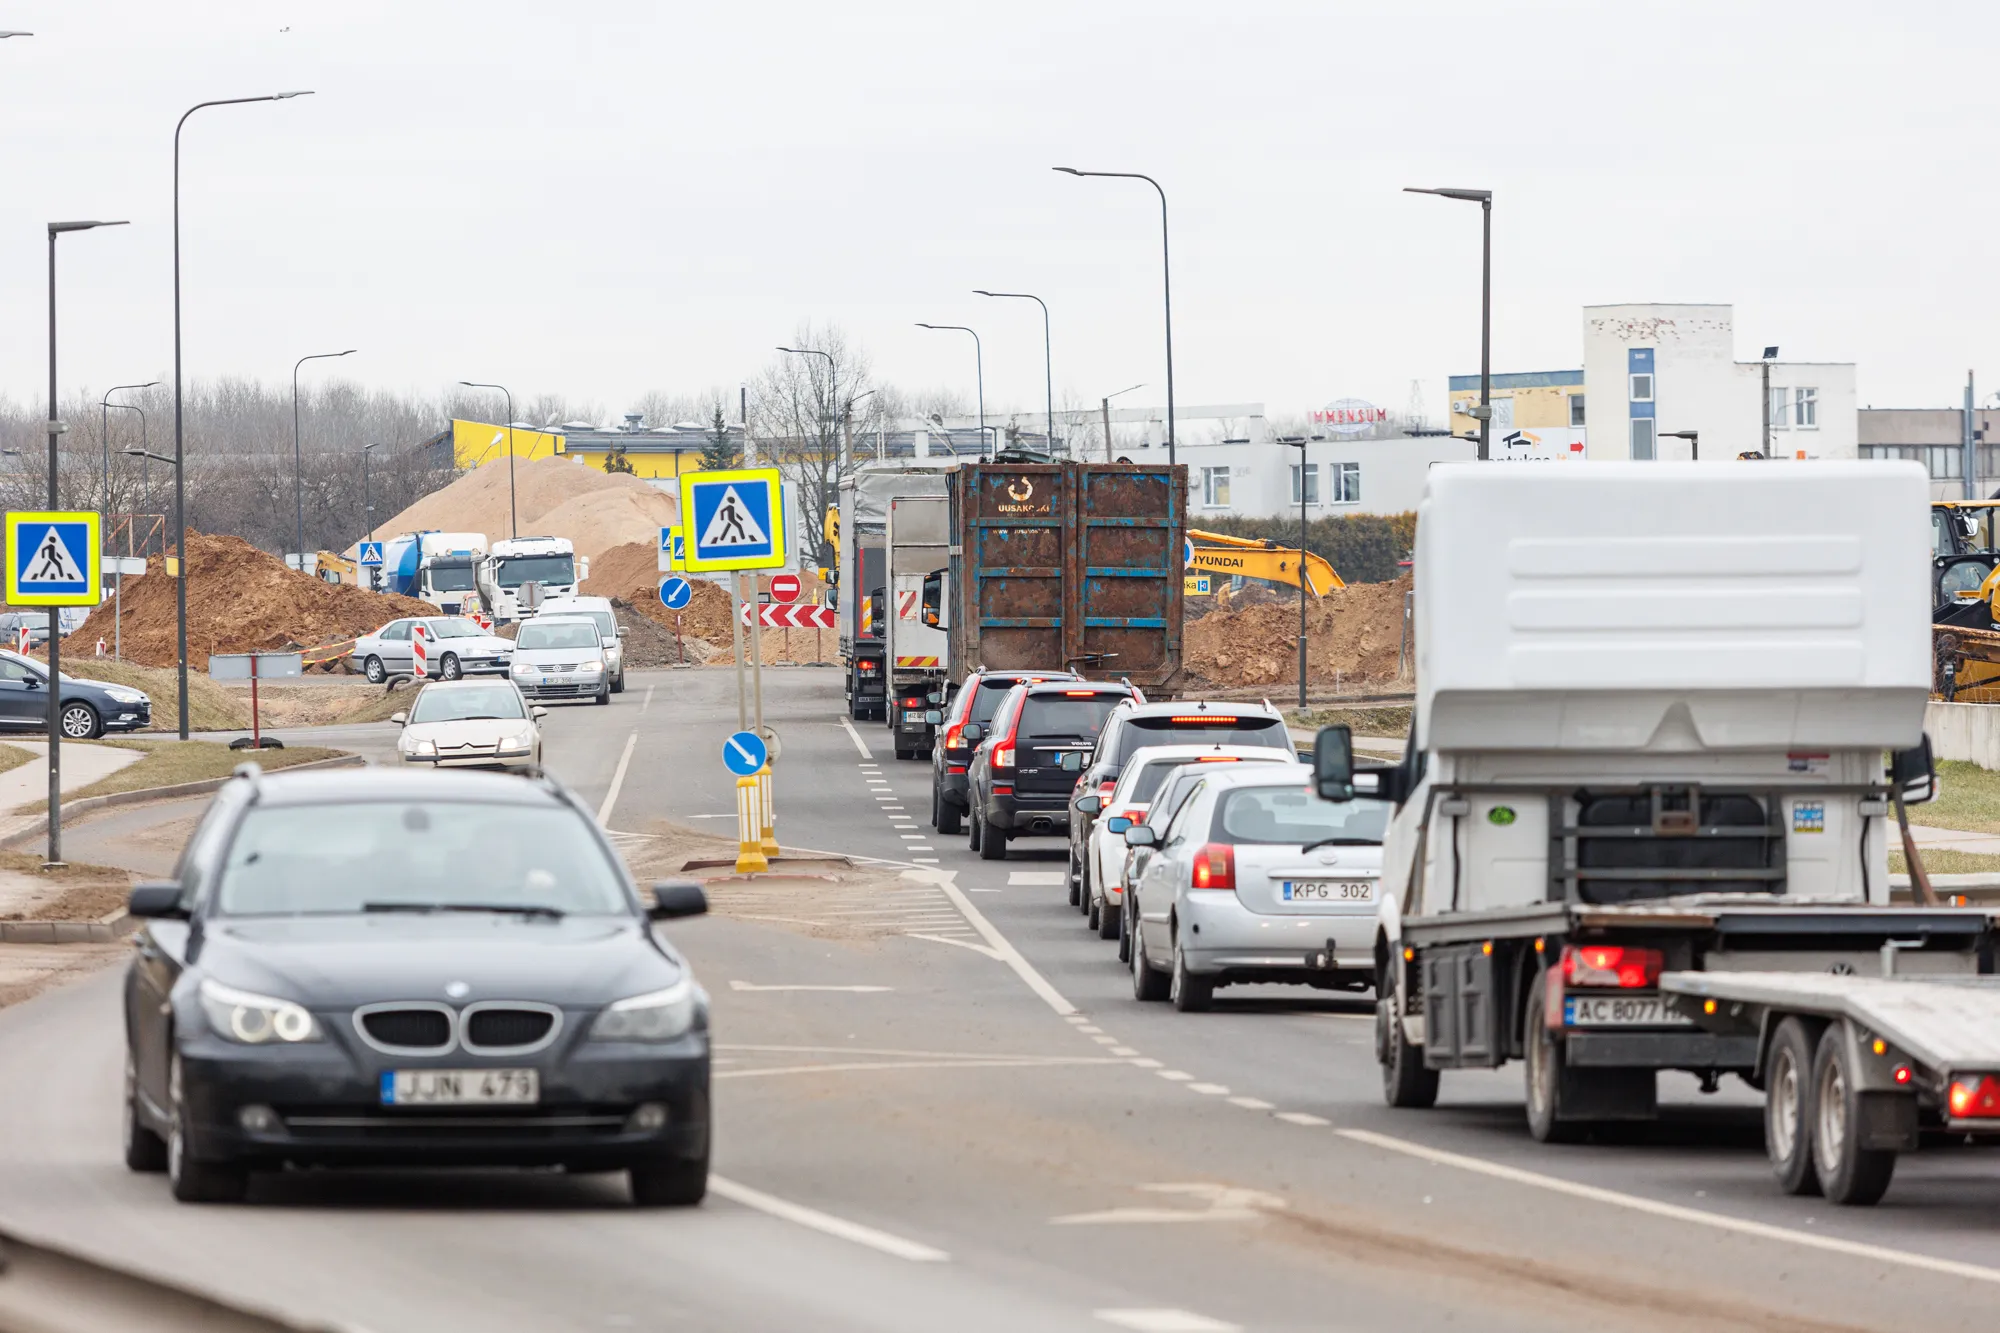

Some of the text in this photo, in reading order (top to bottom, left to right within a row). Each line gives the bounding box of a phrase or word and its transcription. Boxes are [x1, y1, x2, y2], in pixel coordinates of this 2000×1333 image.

[1307, 408, 1387, 424] IMMENSUM
[1294, 884, 1369, 898] KPG 302
[1579, 1001, 1607, 1019] AC
[1613, 1001, 1658, 1020] 8077
[401, 1072, 530, 1098] JJN 479
